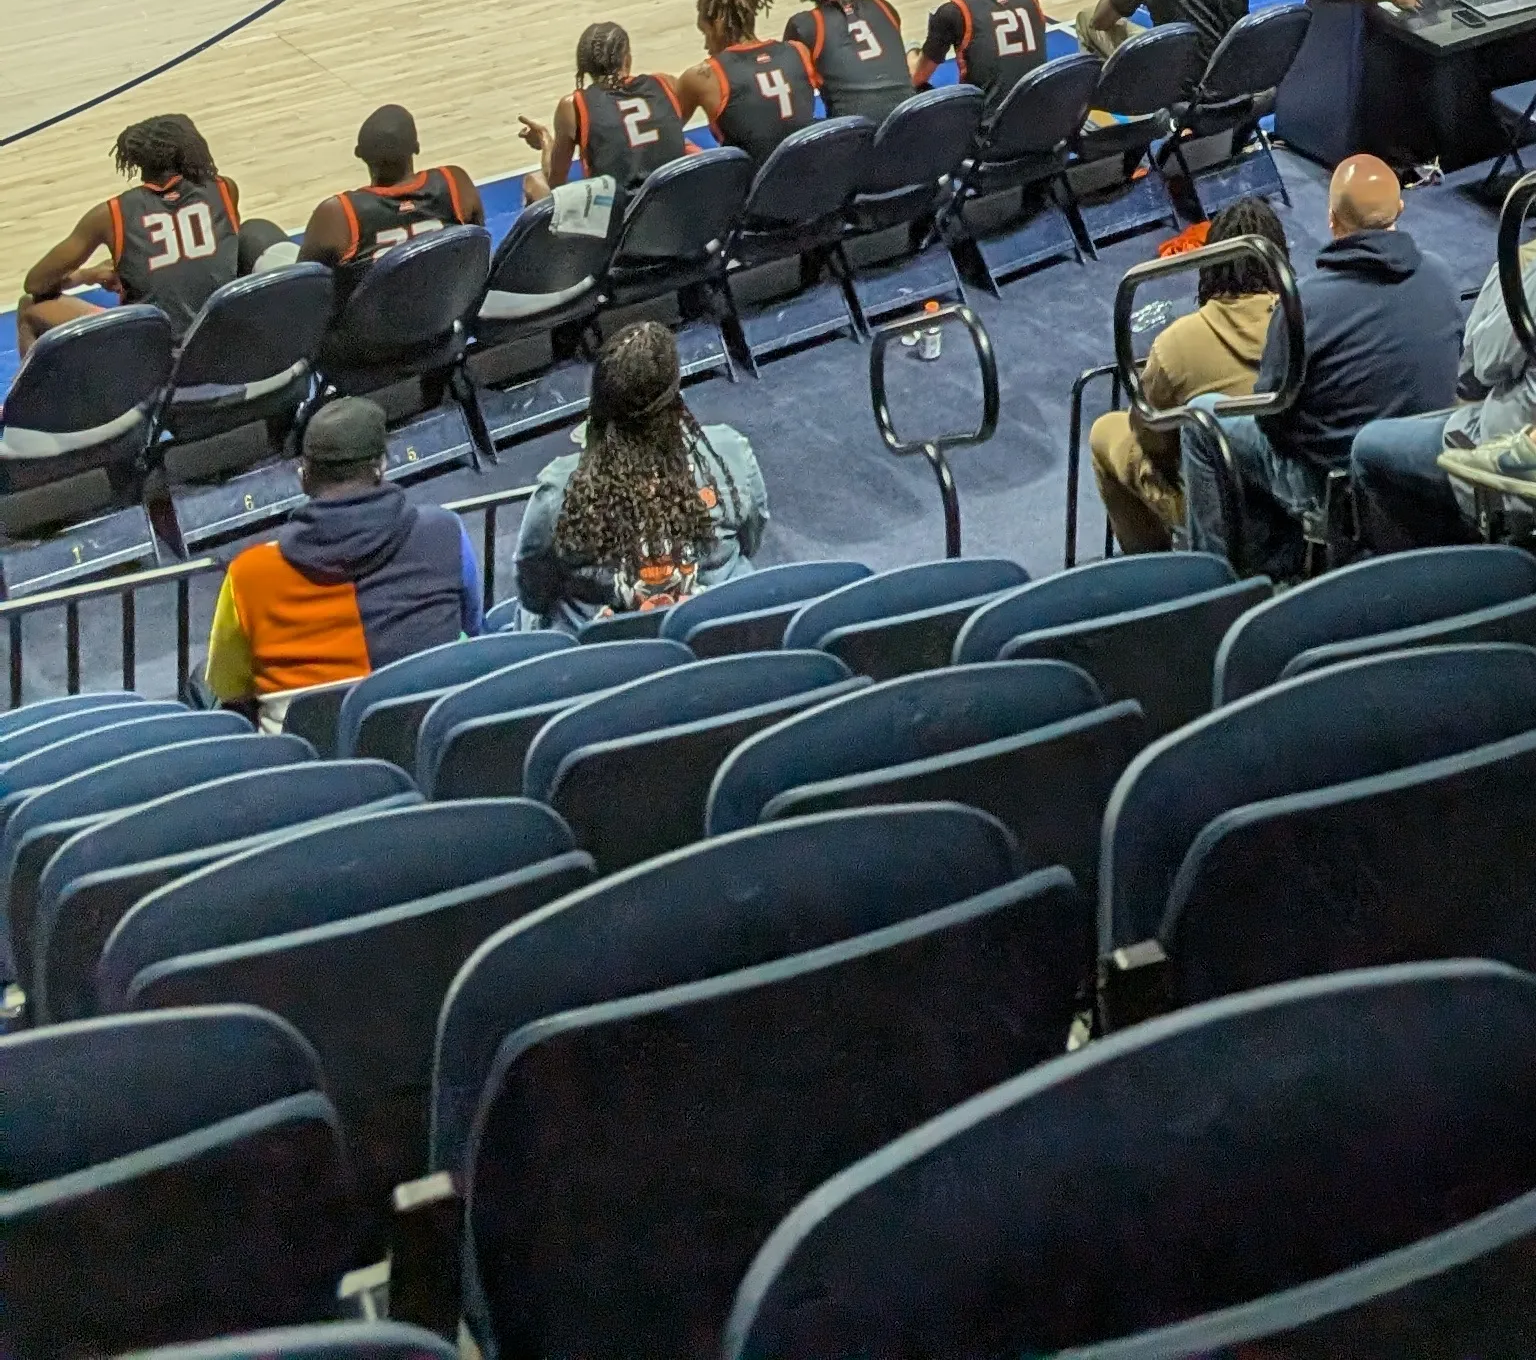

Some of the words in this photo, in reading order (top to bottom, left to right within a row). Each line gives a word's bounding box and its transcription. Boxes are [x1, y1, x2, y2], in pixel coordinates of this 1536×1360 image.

[846, 20, 882, 62] 3
[990, 6, 1036, 58] 21
[755, 68, 793, 120] 4
[616, 97, 659, 147] 2
[141, 201, 216, 271] 30
